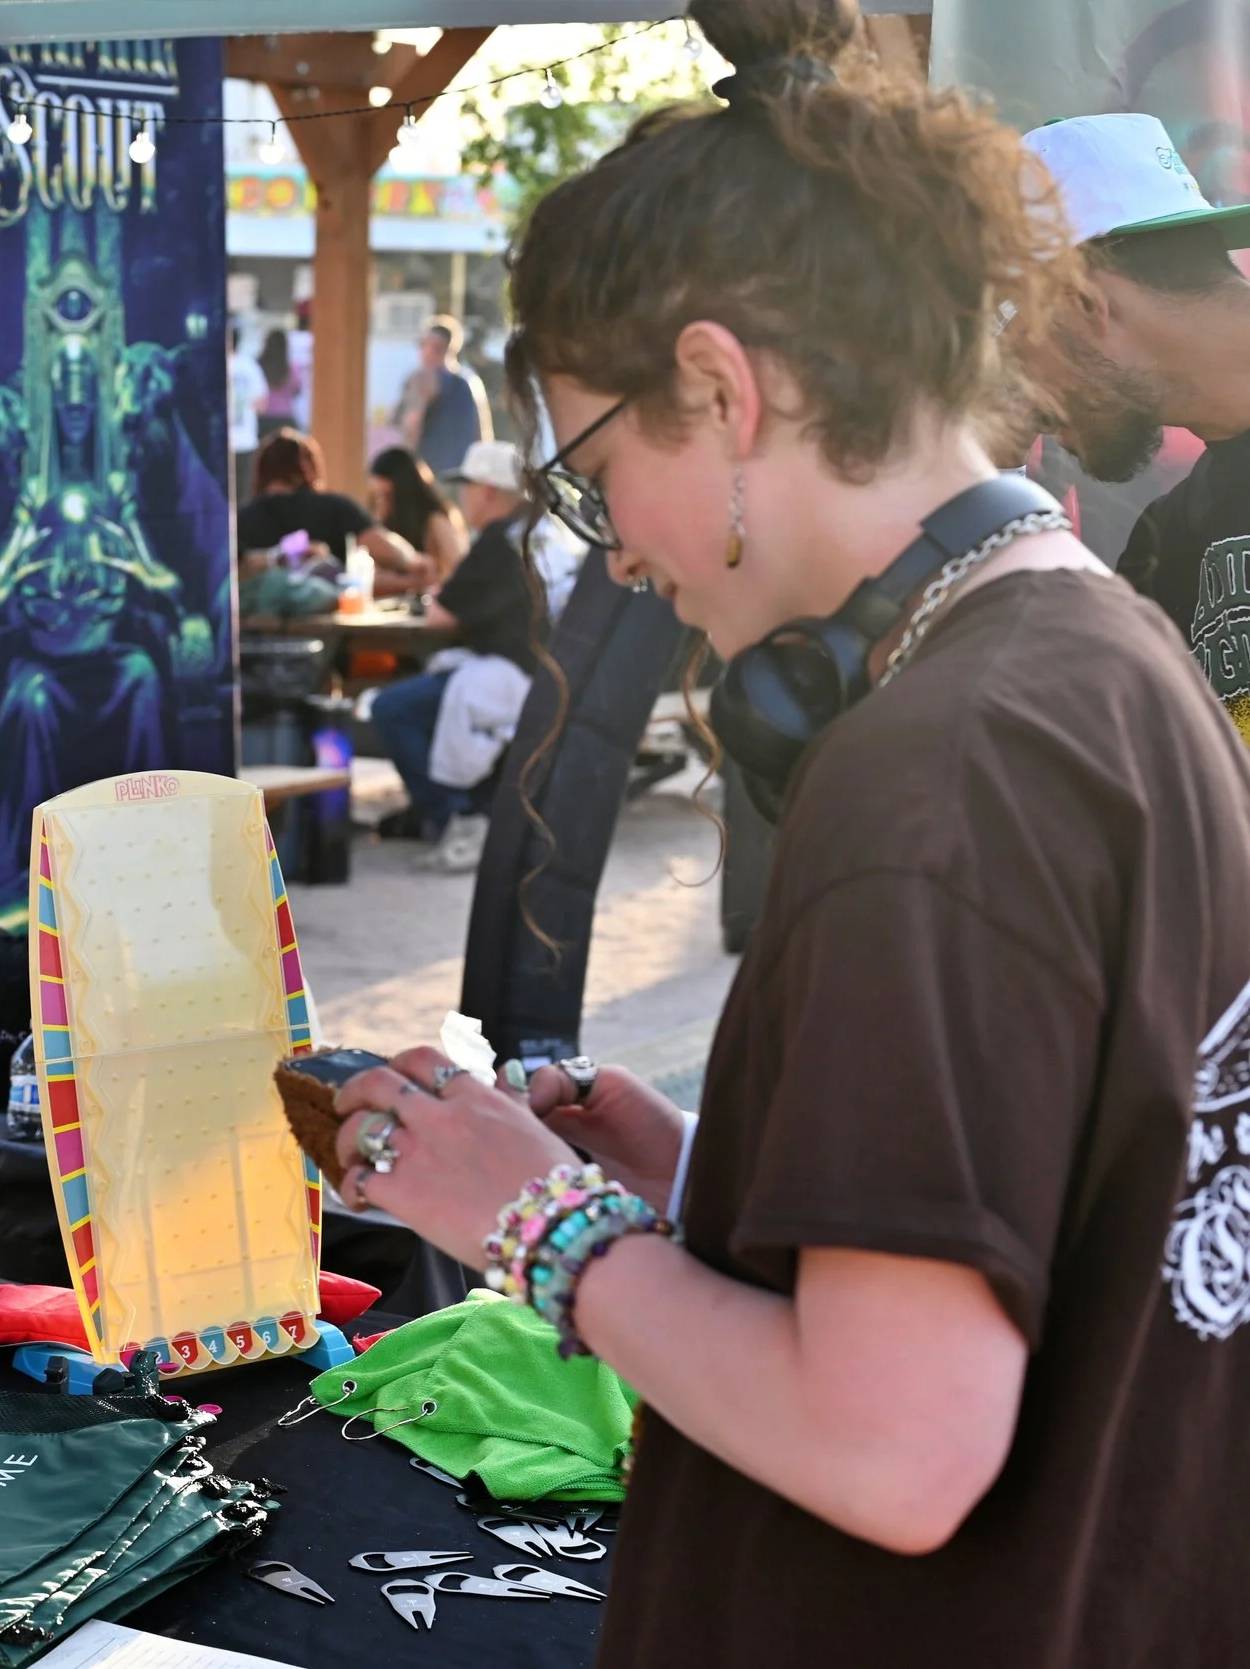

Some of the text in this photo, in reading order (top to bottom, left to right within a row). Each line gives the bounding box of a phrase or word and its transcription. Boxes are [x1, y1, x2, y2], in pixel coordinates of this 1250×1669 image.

[181, 1345, 191, 1359] 3
[208, 1339, 218, 1353] 4
[236, 1335, 246, 1349] 5
[262, 1330, 272, 1344] 6
[288, 1325, 299, 1339] 7
